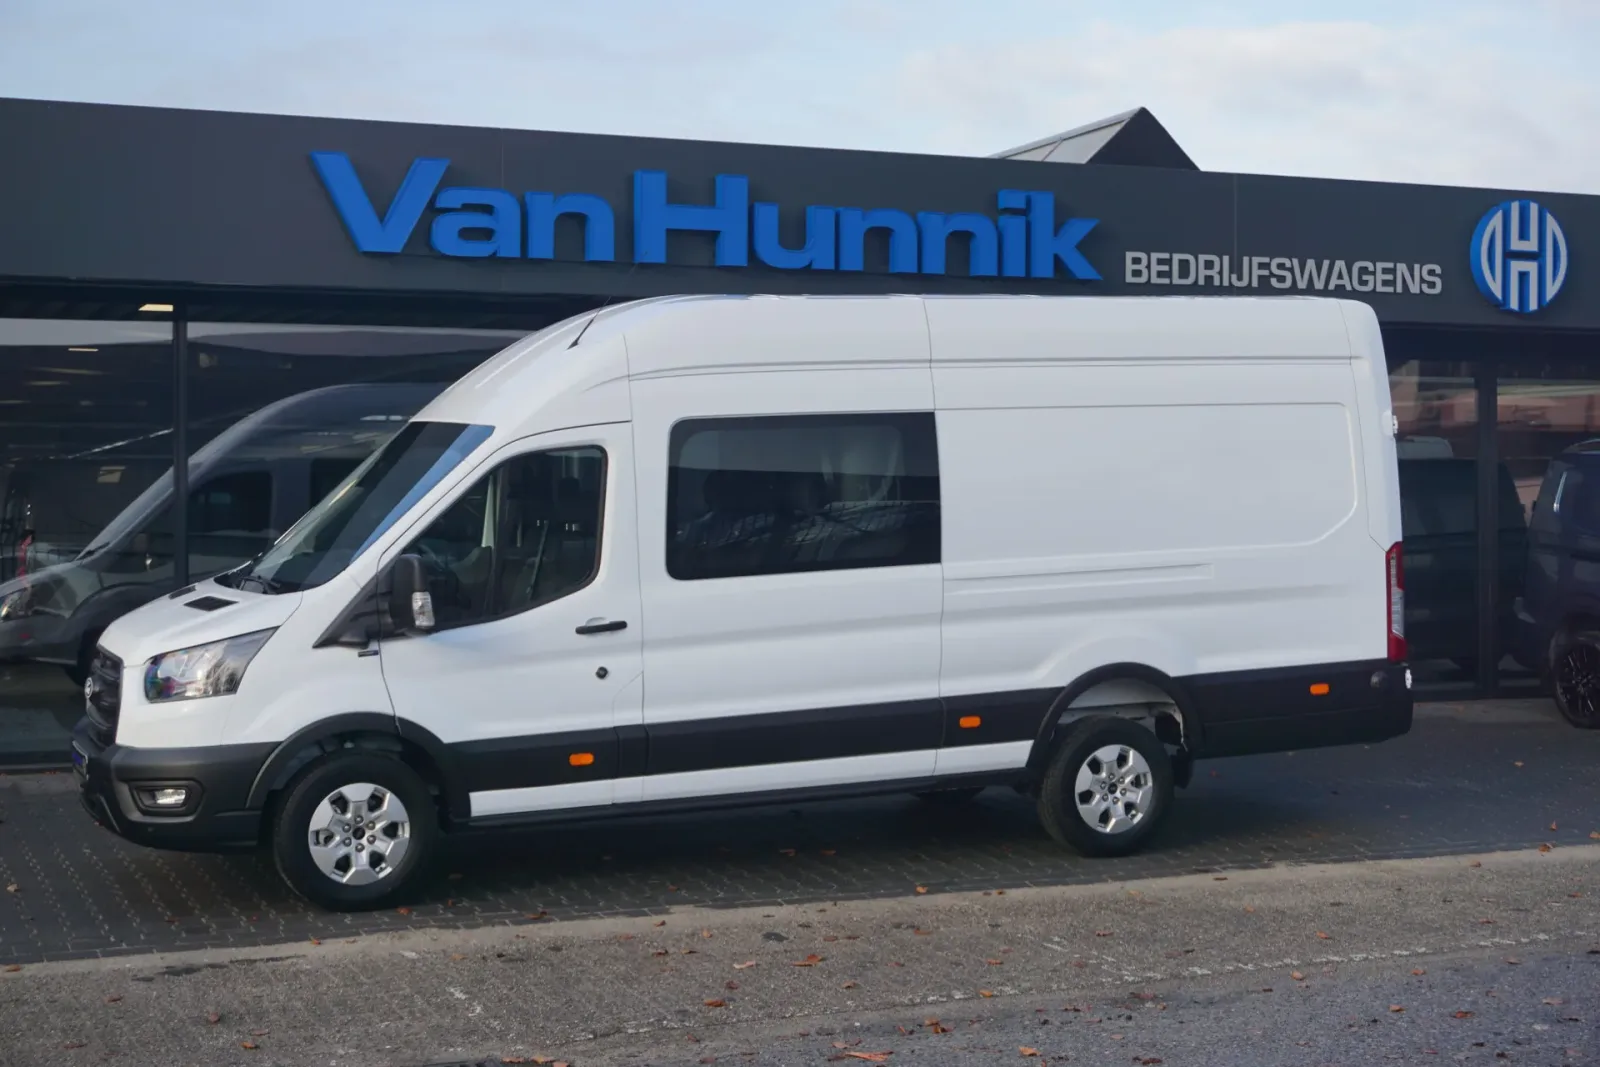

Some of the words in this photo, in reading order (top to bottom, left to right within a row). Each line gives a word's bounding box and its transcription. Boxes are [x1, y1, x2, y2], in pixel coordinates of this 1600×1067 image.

[311, 151, 615, 261] Van
[634, 171, 1102, 280] Hunnik
[1125, 251, 1442, 294] BEDRIJFSWAGENS
